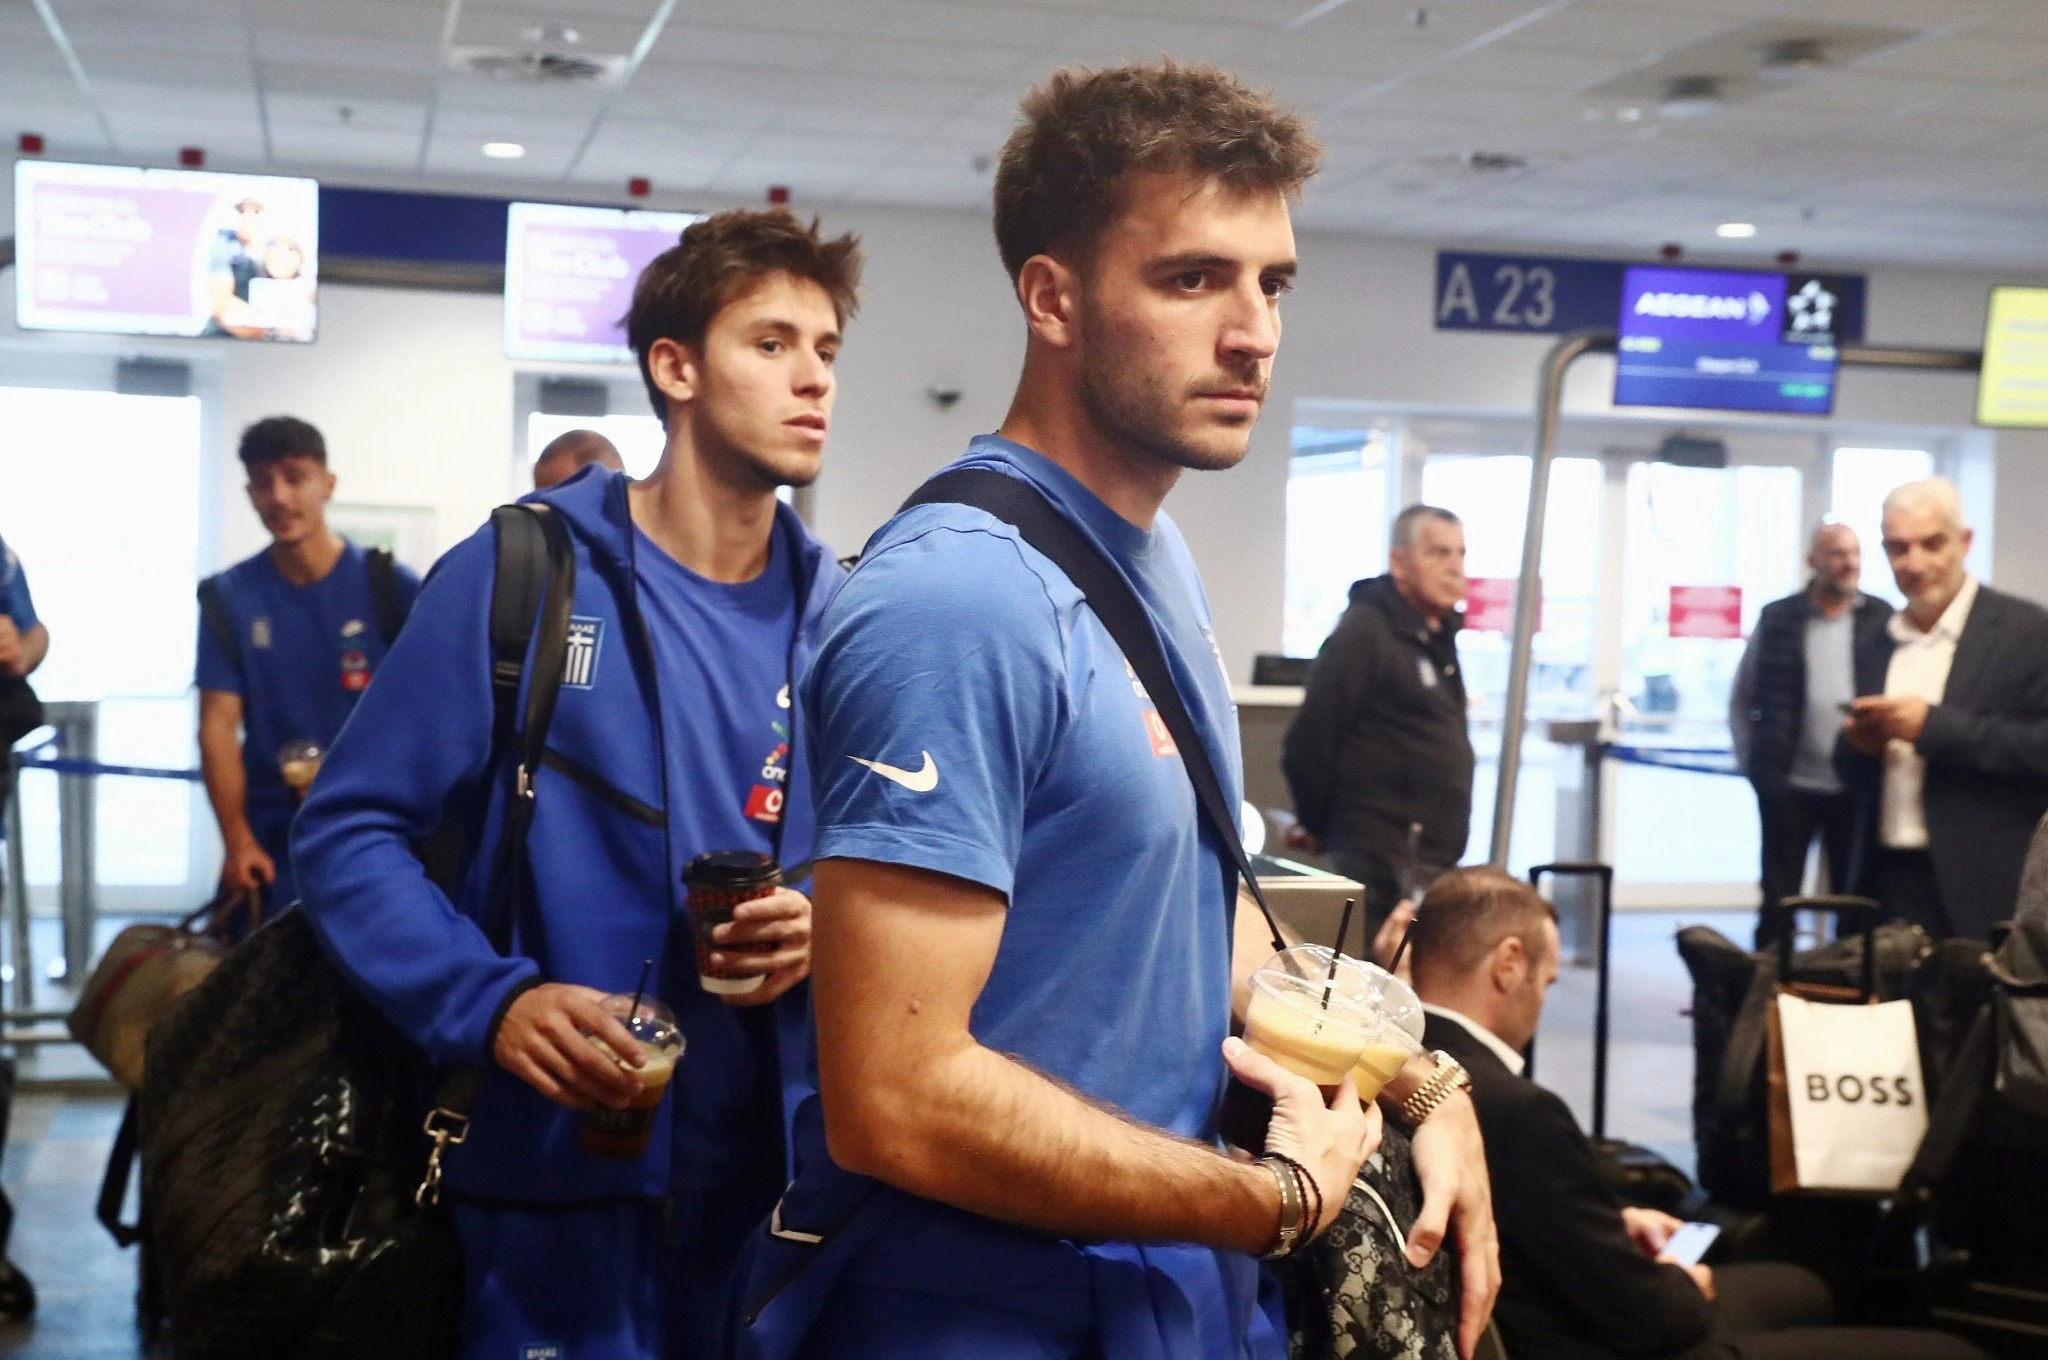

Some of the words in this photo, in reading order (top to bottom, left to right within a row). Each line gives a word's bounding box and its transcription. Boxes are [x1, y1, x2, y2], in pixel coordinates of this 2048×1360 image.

[1440, 262, 1478, 321] A
[1493, 265, 1554, 326] 23
[1806, 1074, 1913, 1107] BOSS
